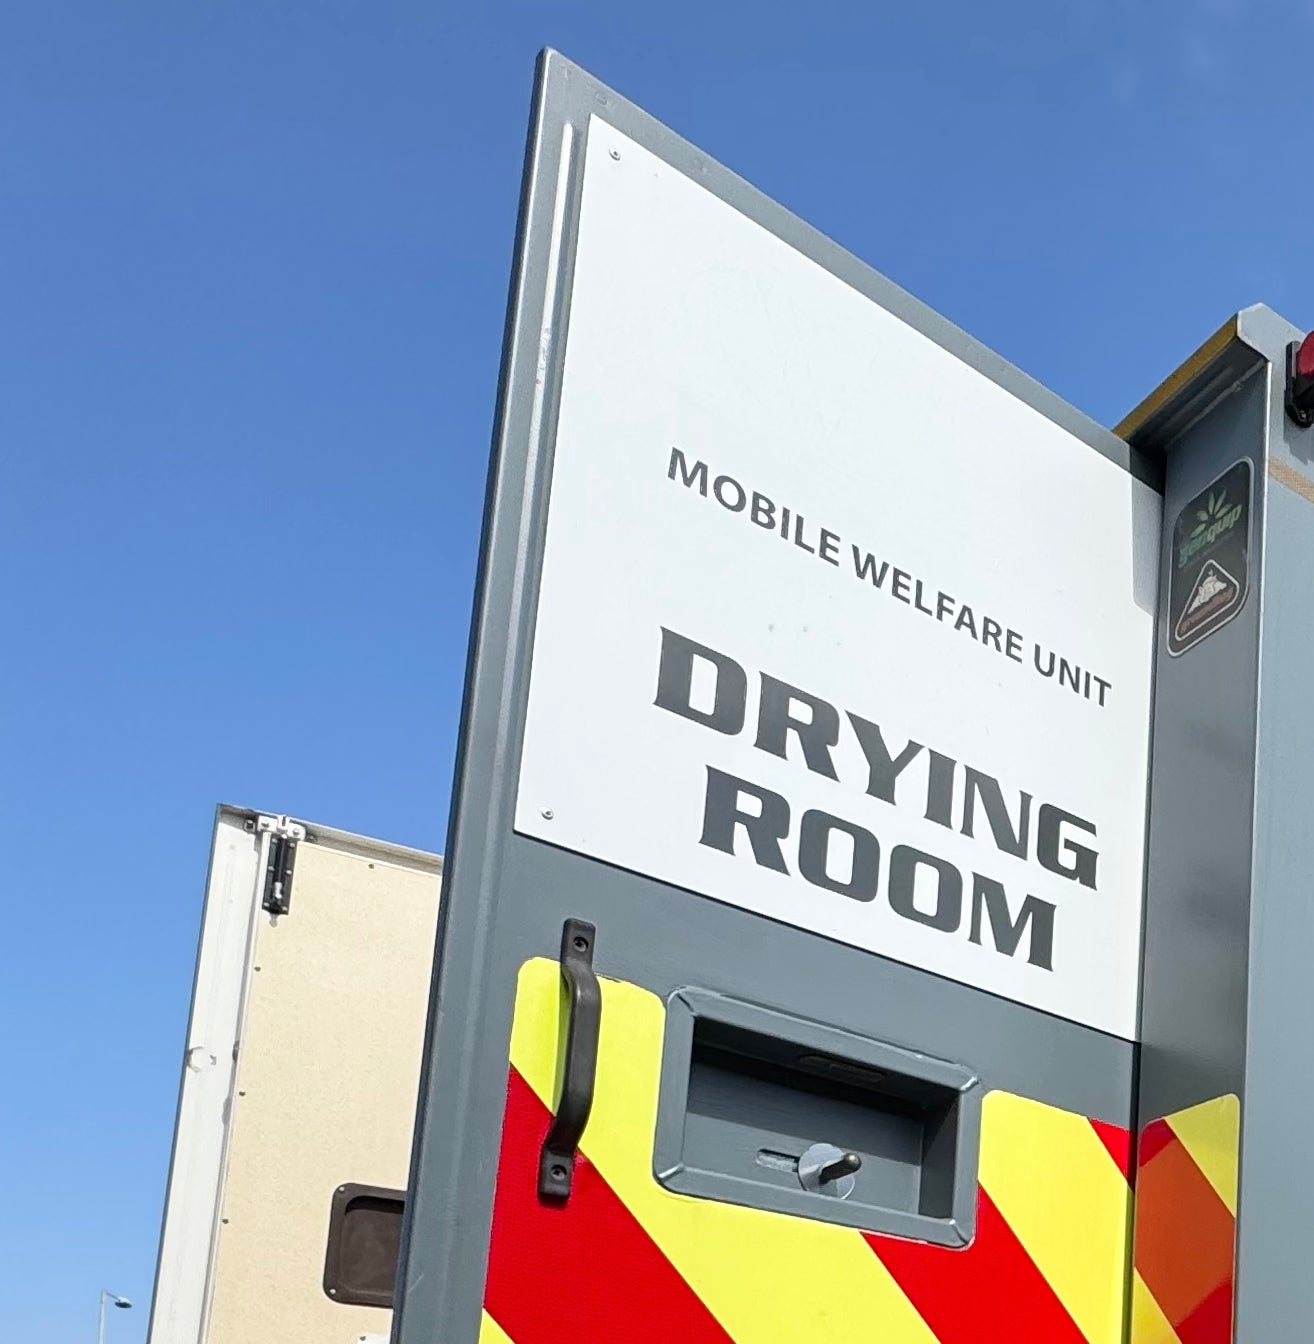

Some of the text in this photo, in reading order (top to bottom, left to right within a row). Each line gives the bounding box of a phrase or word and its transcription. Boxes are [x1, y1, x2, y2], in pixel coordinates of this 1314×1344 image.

[667, 446, 1112, 707] MOBILE WELFARE UNIT
[652, 626, 1100, 891] DRYING
[698, 764, 1057, 972] ROOM
